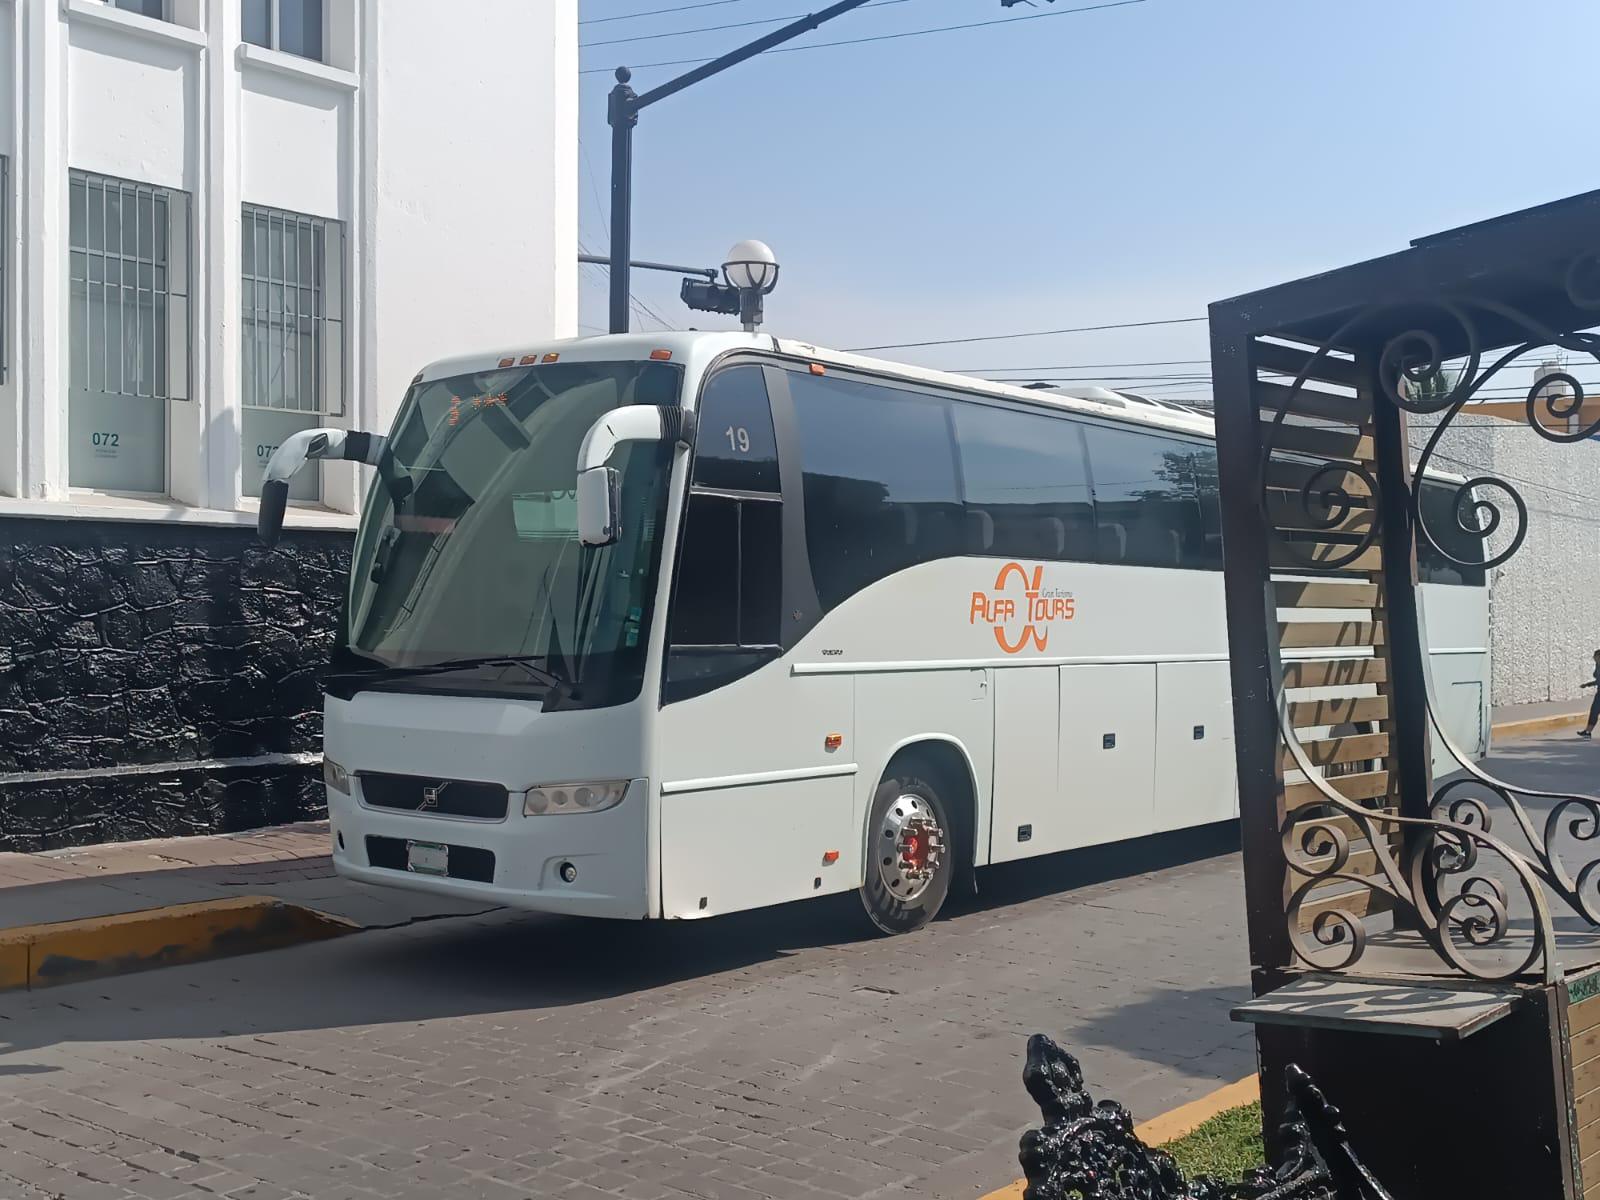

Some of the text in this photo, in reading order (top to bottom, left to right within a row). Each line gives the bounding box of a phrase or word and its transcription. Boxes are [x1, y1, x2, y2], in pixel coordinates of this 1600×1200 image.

[92, 432, 120, 447] 072
[725, 425, 750, 453] 19
[970, 591, 1015, 624] ALFA
